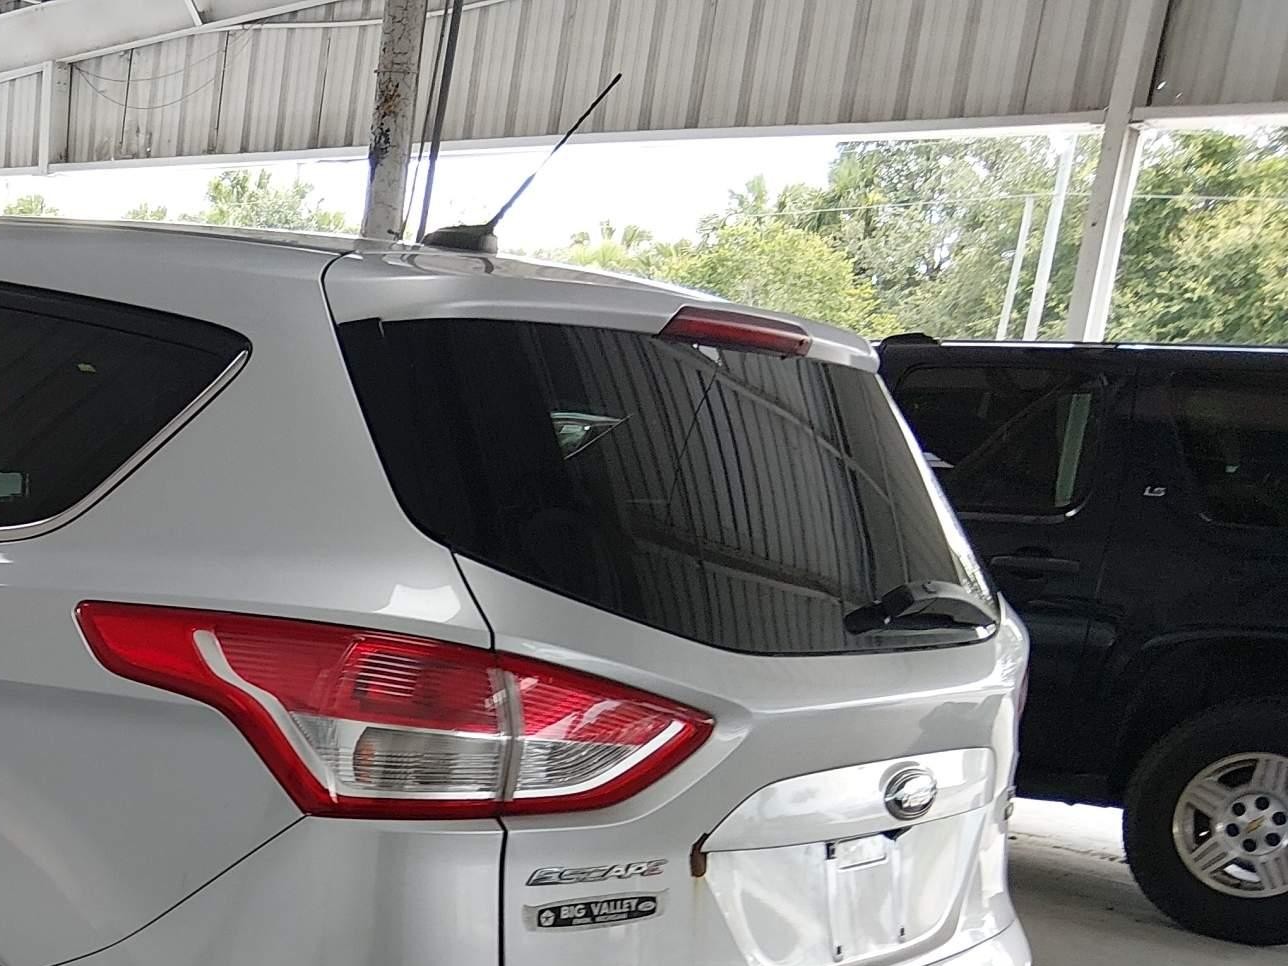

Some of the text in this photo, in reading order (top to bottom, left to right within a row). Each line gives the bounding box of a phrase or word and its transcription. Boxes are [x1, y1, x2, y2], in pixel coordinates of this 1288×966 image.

[1143, 486, 1166, 497] LS
[525, 858, 669, 886] ESCAPE
[559, 904, 586, 920] BIG
[591, 898, 639, 915] VALLEY
